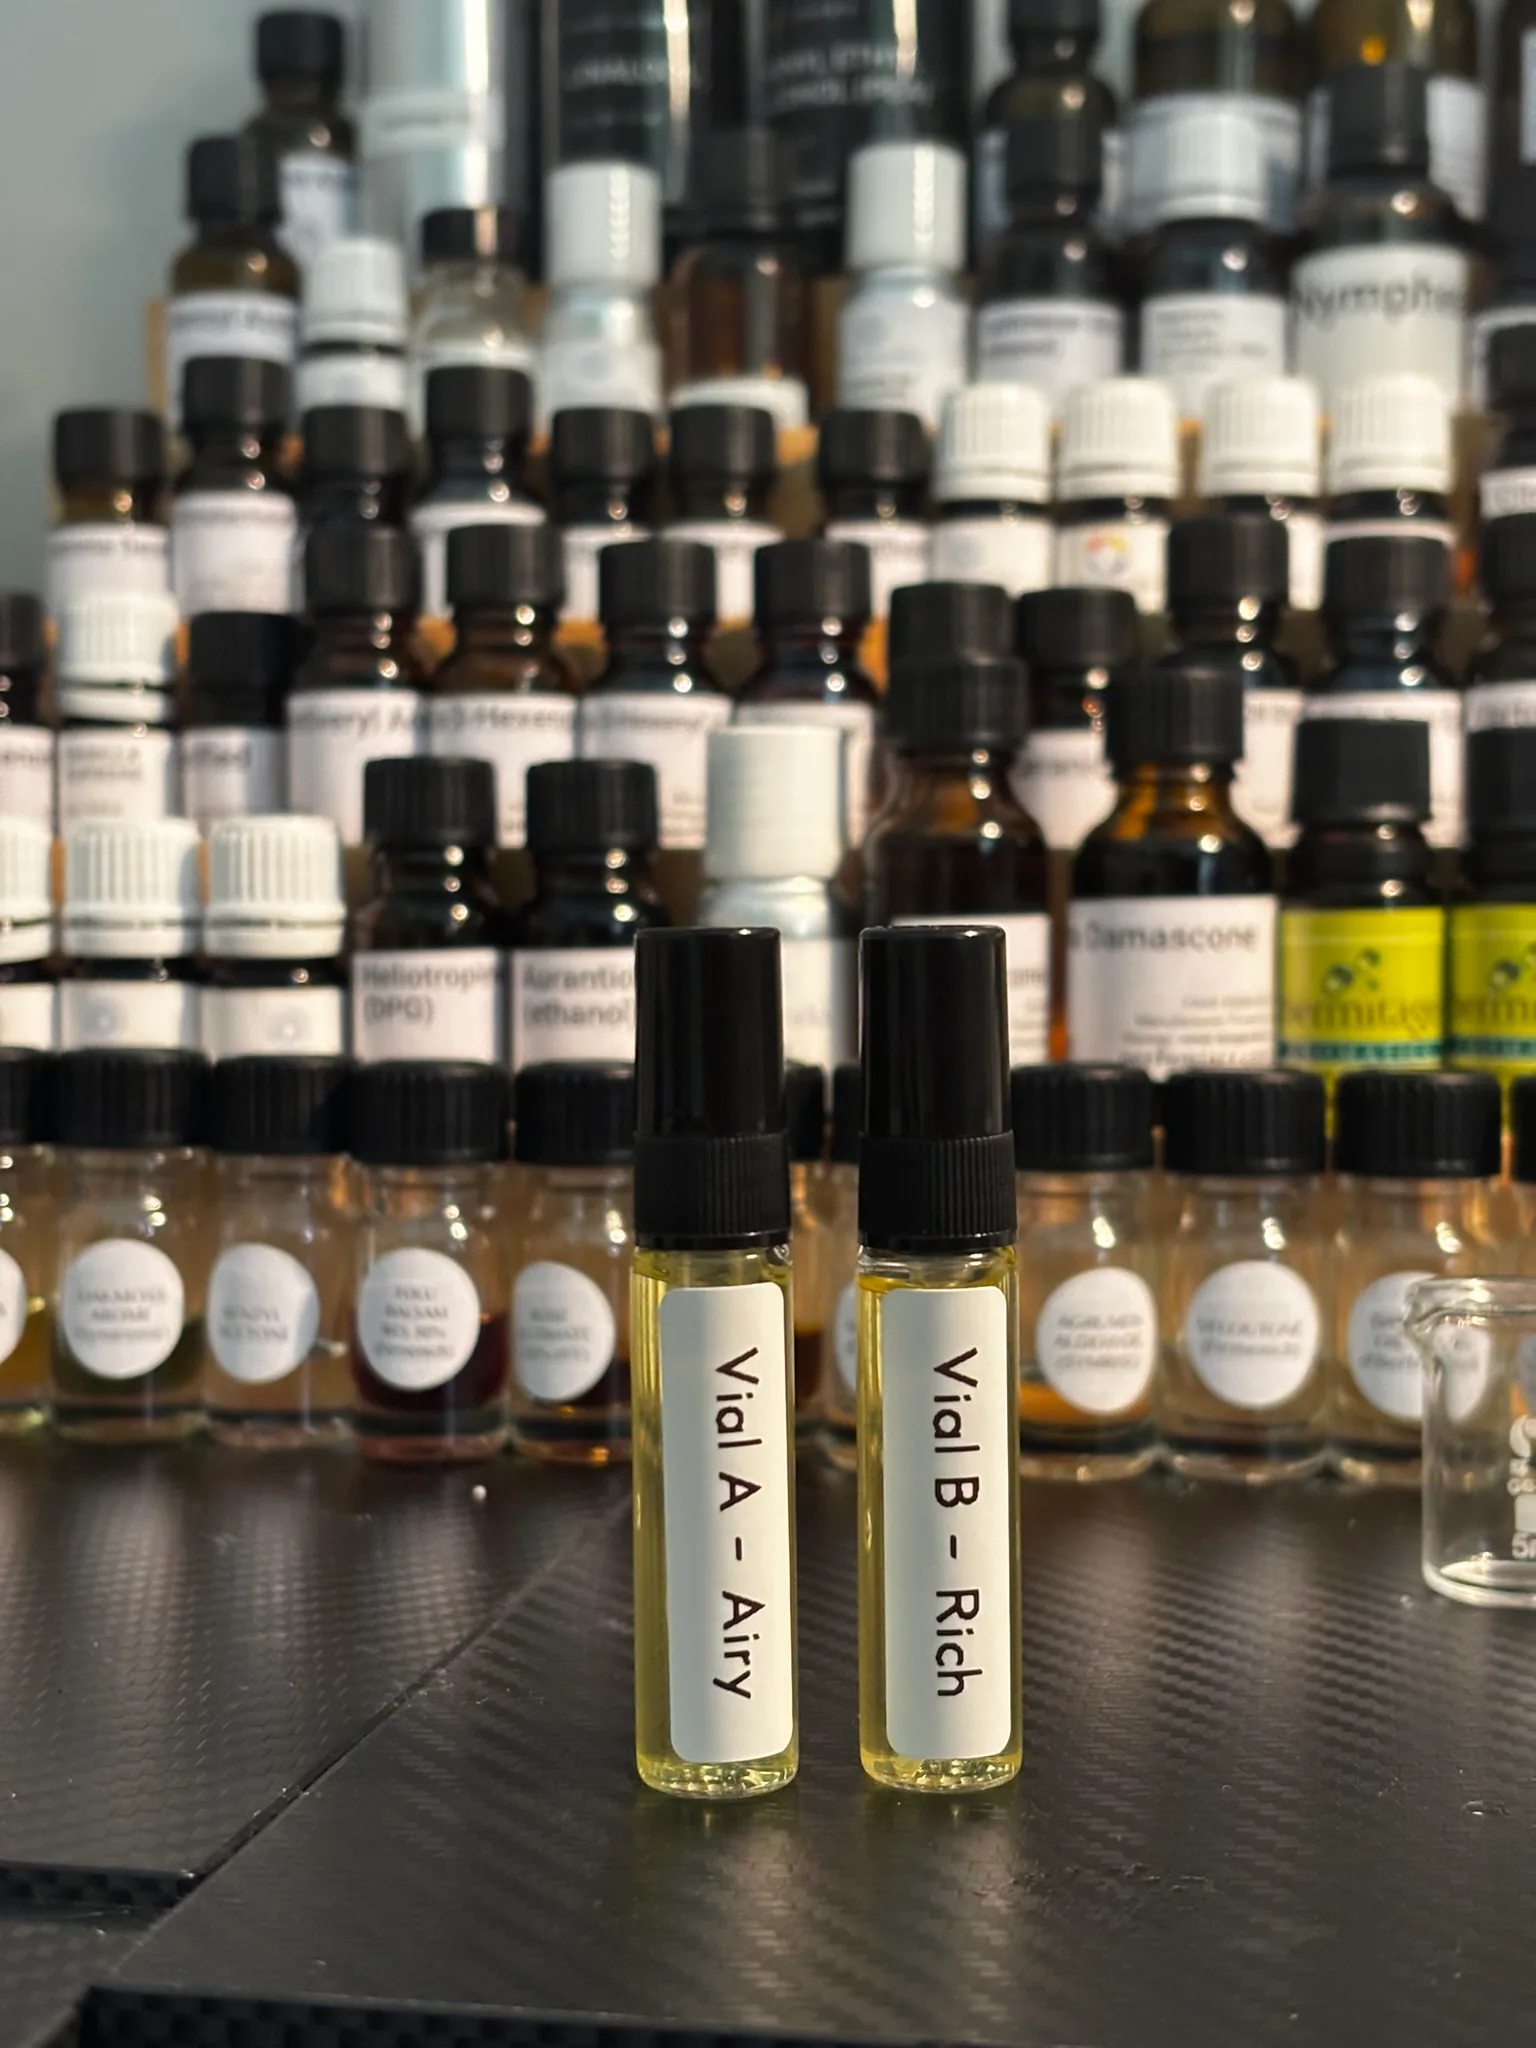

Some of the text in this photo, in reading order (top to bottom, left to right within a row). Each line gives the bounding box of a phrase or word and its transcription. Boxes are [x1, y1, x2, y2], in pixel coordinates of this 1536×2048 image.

[1085, 920, 1259, 951] Damascone
[523, 962, 634, 990] Aurantio
[715, 1347, 763, 1449] Vial
[932, 1347, 981, 1454] Vial
[718, 1471, 762, 1513] A
[934, 1476, 980, 1509] B
[712, 1590, 766, 1699] Airy
[935, 1589, 983, 1697] Rich
